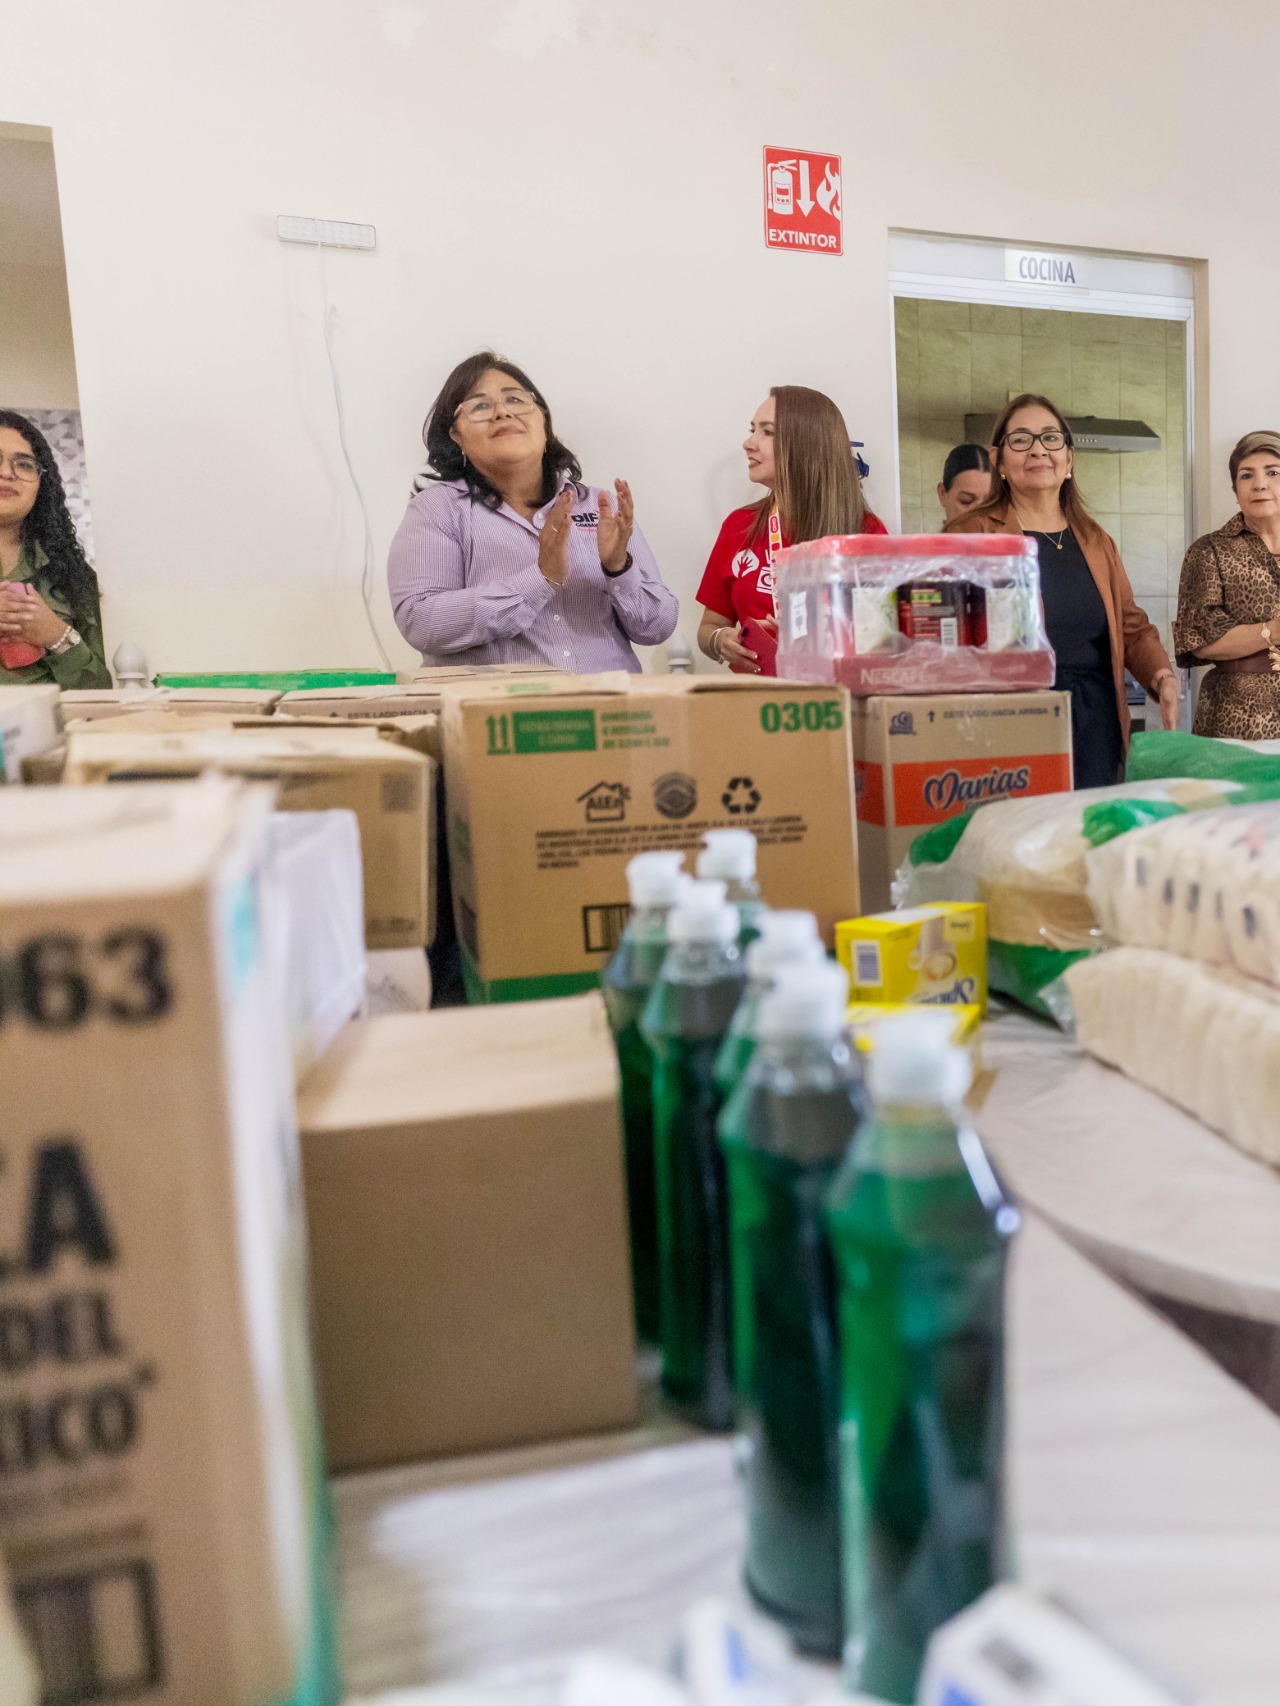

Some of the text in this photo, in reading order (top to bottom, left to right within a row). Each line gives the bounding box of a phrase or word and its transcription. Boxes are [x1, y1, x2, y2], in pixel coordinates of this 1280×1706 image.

[768, 228, 837, 249] EXTINTOR
[1019, 255, 1076, 284] COCINA
[571, 512, 598, 523] DIF
[760, 701, 843, 733] 0305
